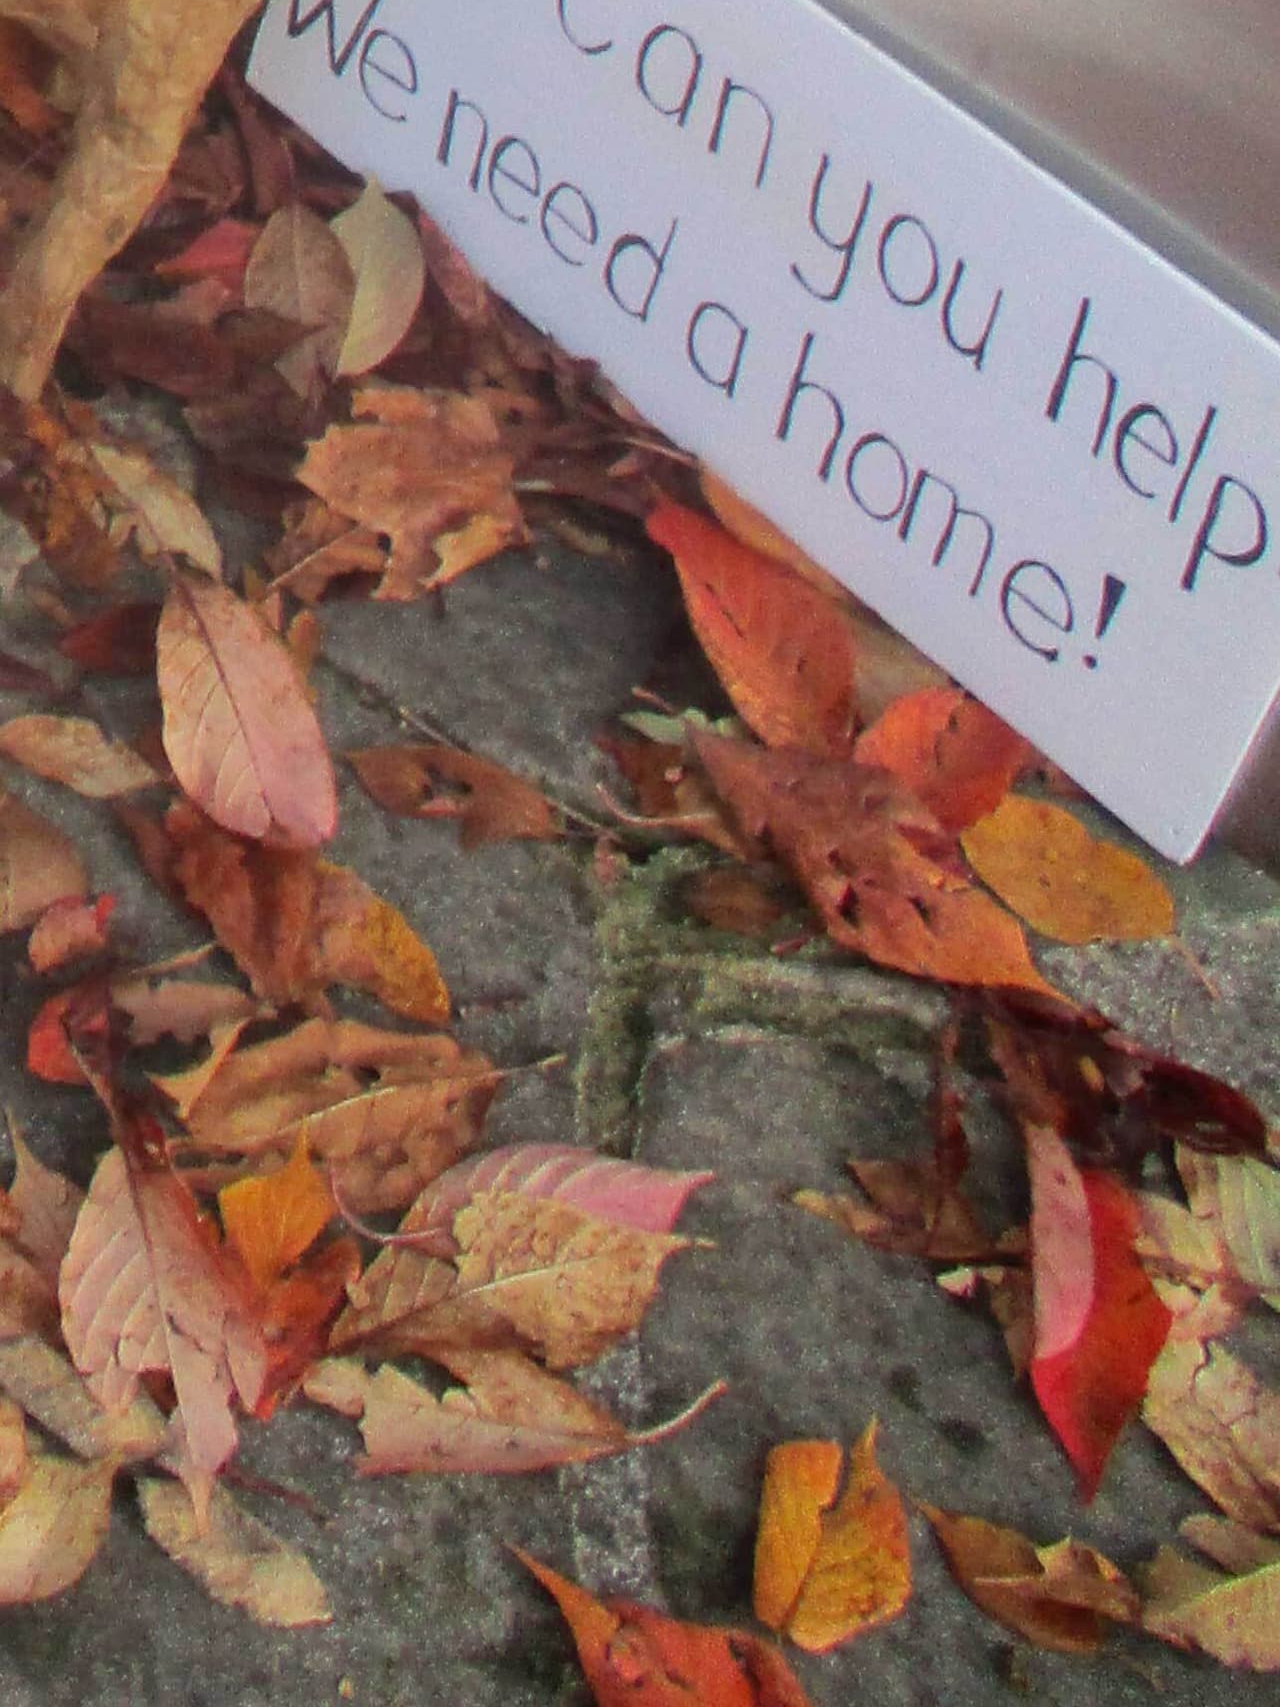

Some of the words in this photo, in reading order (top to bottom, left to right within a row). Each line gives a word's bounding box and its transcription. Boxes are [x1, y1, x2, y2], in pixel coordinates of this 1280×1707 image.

[436, 89, 680, 323] need
[685, 297, 749, 400] a
[775, 331, 1128, 670] home!
[790, 153, 1005, 372] you
